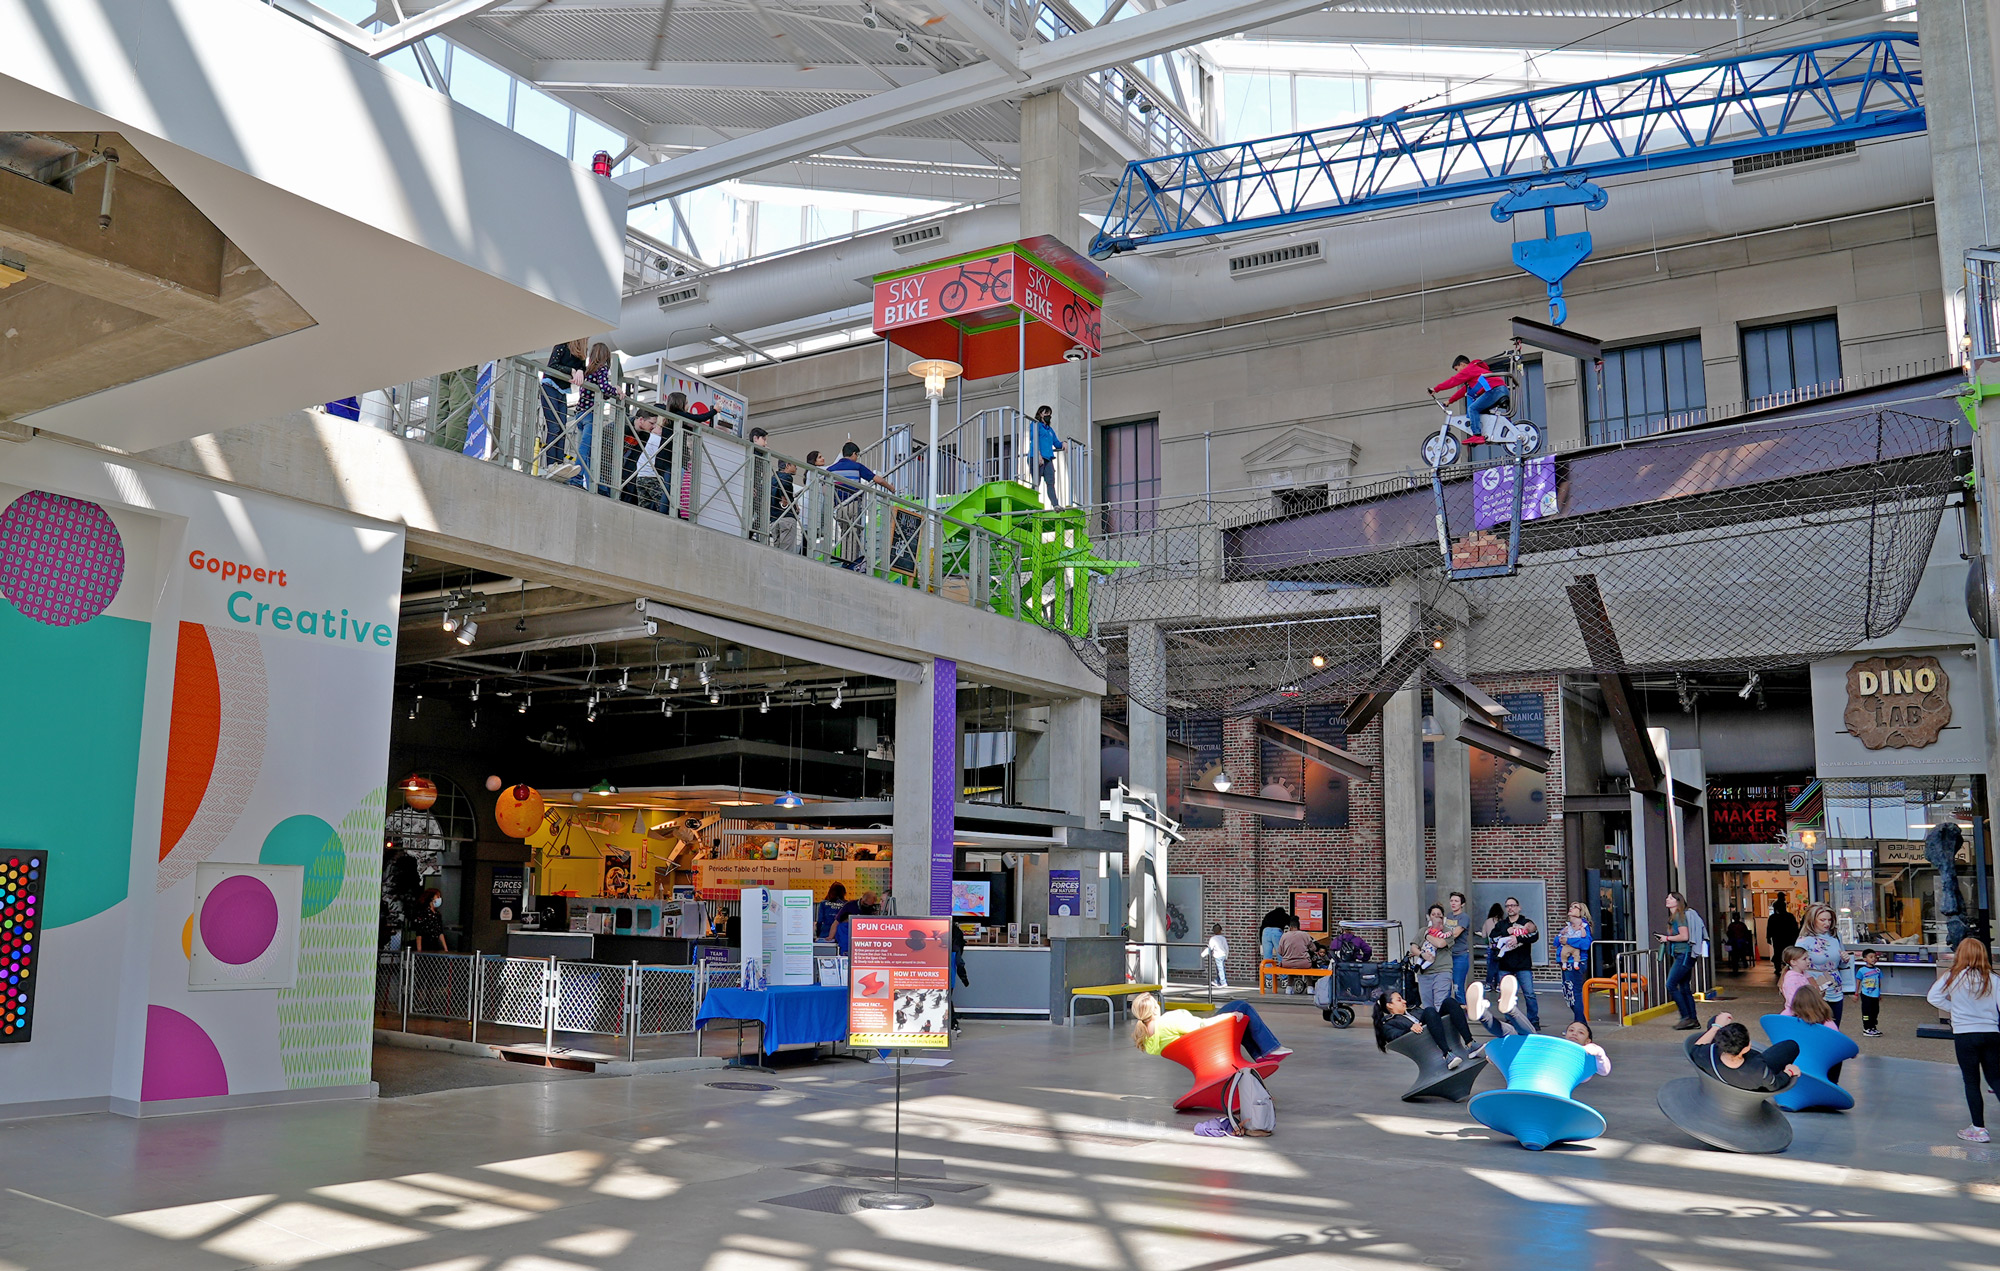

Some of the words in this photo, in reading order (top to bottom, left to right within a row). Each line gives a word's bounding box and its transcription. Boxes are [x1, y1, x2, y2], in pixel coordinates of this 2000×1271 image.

[889, 276, 926, 304] SKY
[1028, 266, 1051, 298] SKY
[884, 298, 928, 325] BIKE
[1025, 288, 1053, 321] BIKE
[1504, 457, 1544, 482] EIT
[1493, 505, 1512, 514] Amazin
[188, 550, 287, 586] Goppert
[227, 591, 393, 647] Creative
[1859, 668, 1936, 696] DINO
[1503, 712, 1542, 721] ECHANICAL
[1876, 706, 1922, 728] LAB
[1714, 809, 1777, 823] MAKER
[1718, 824, 1776, 832] studio
